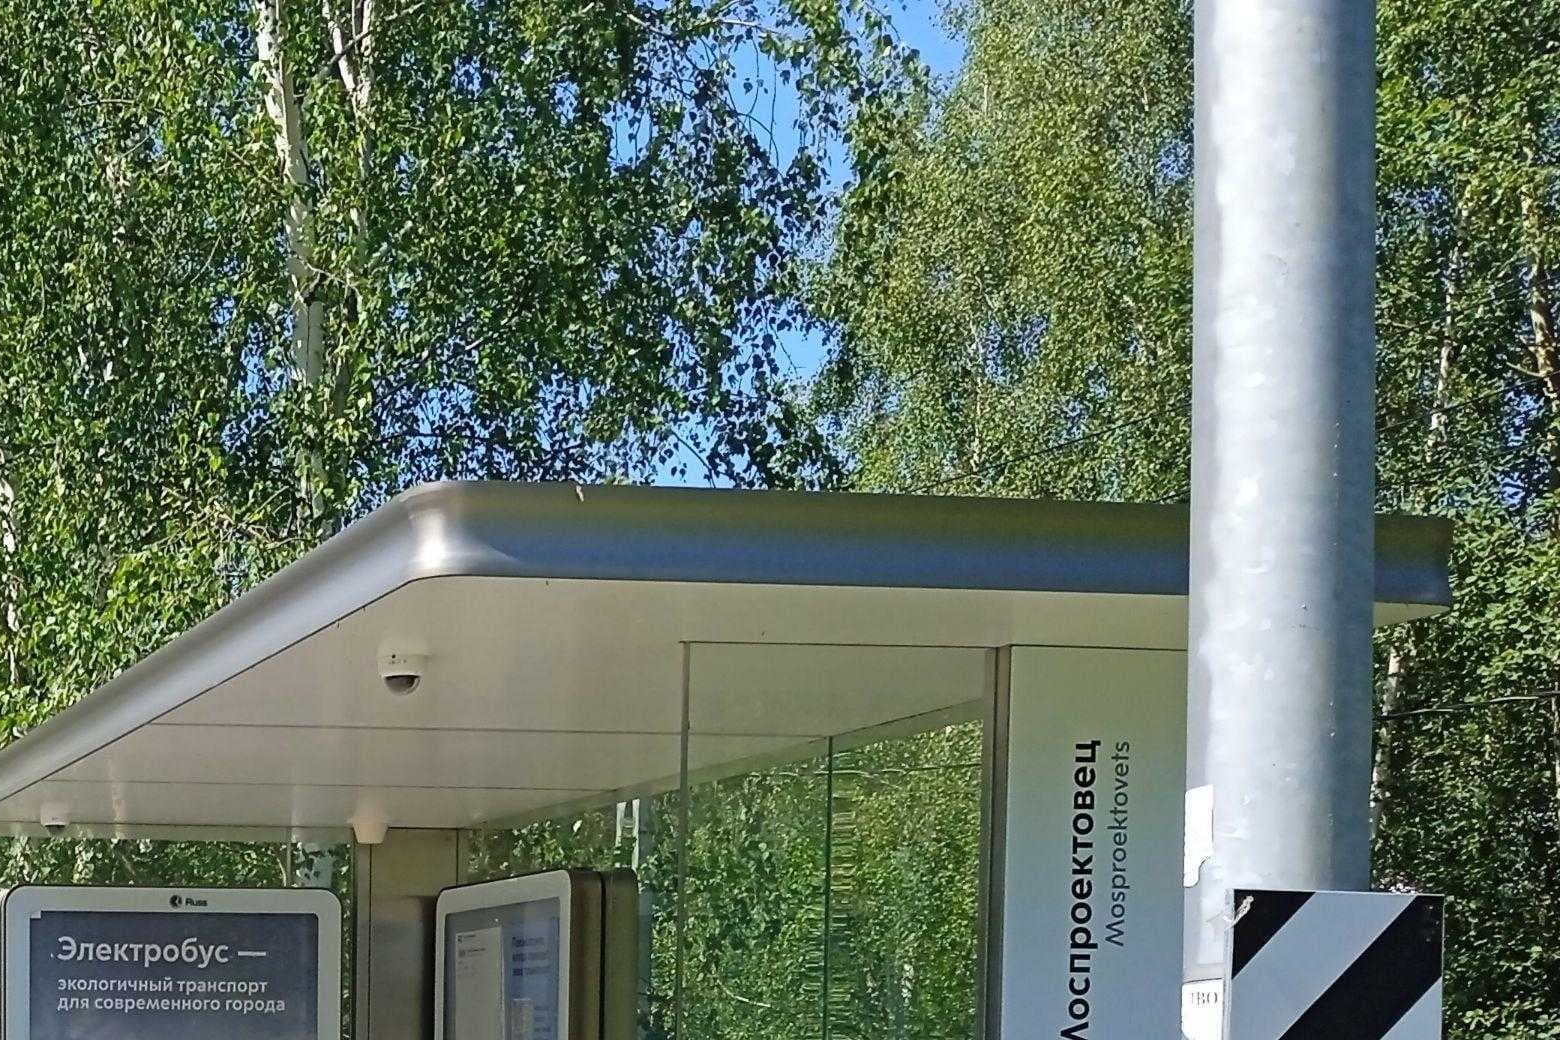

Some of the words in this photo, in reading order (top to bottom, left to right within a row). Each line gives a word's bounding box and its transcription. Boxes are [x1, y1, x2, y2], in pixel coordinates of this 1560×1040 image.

[1104, 740, 1130, 947] Mosproektovets
[57, 935, 229, 969] Электробус
[57, 976, 173, 993] экологичный
[177, 980, 268, 997] транспорт
[57, 997, 90, 1012] для
[94, 998, 221, 1014] современного
[225, 999, 286, 1015] города
